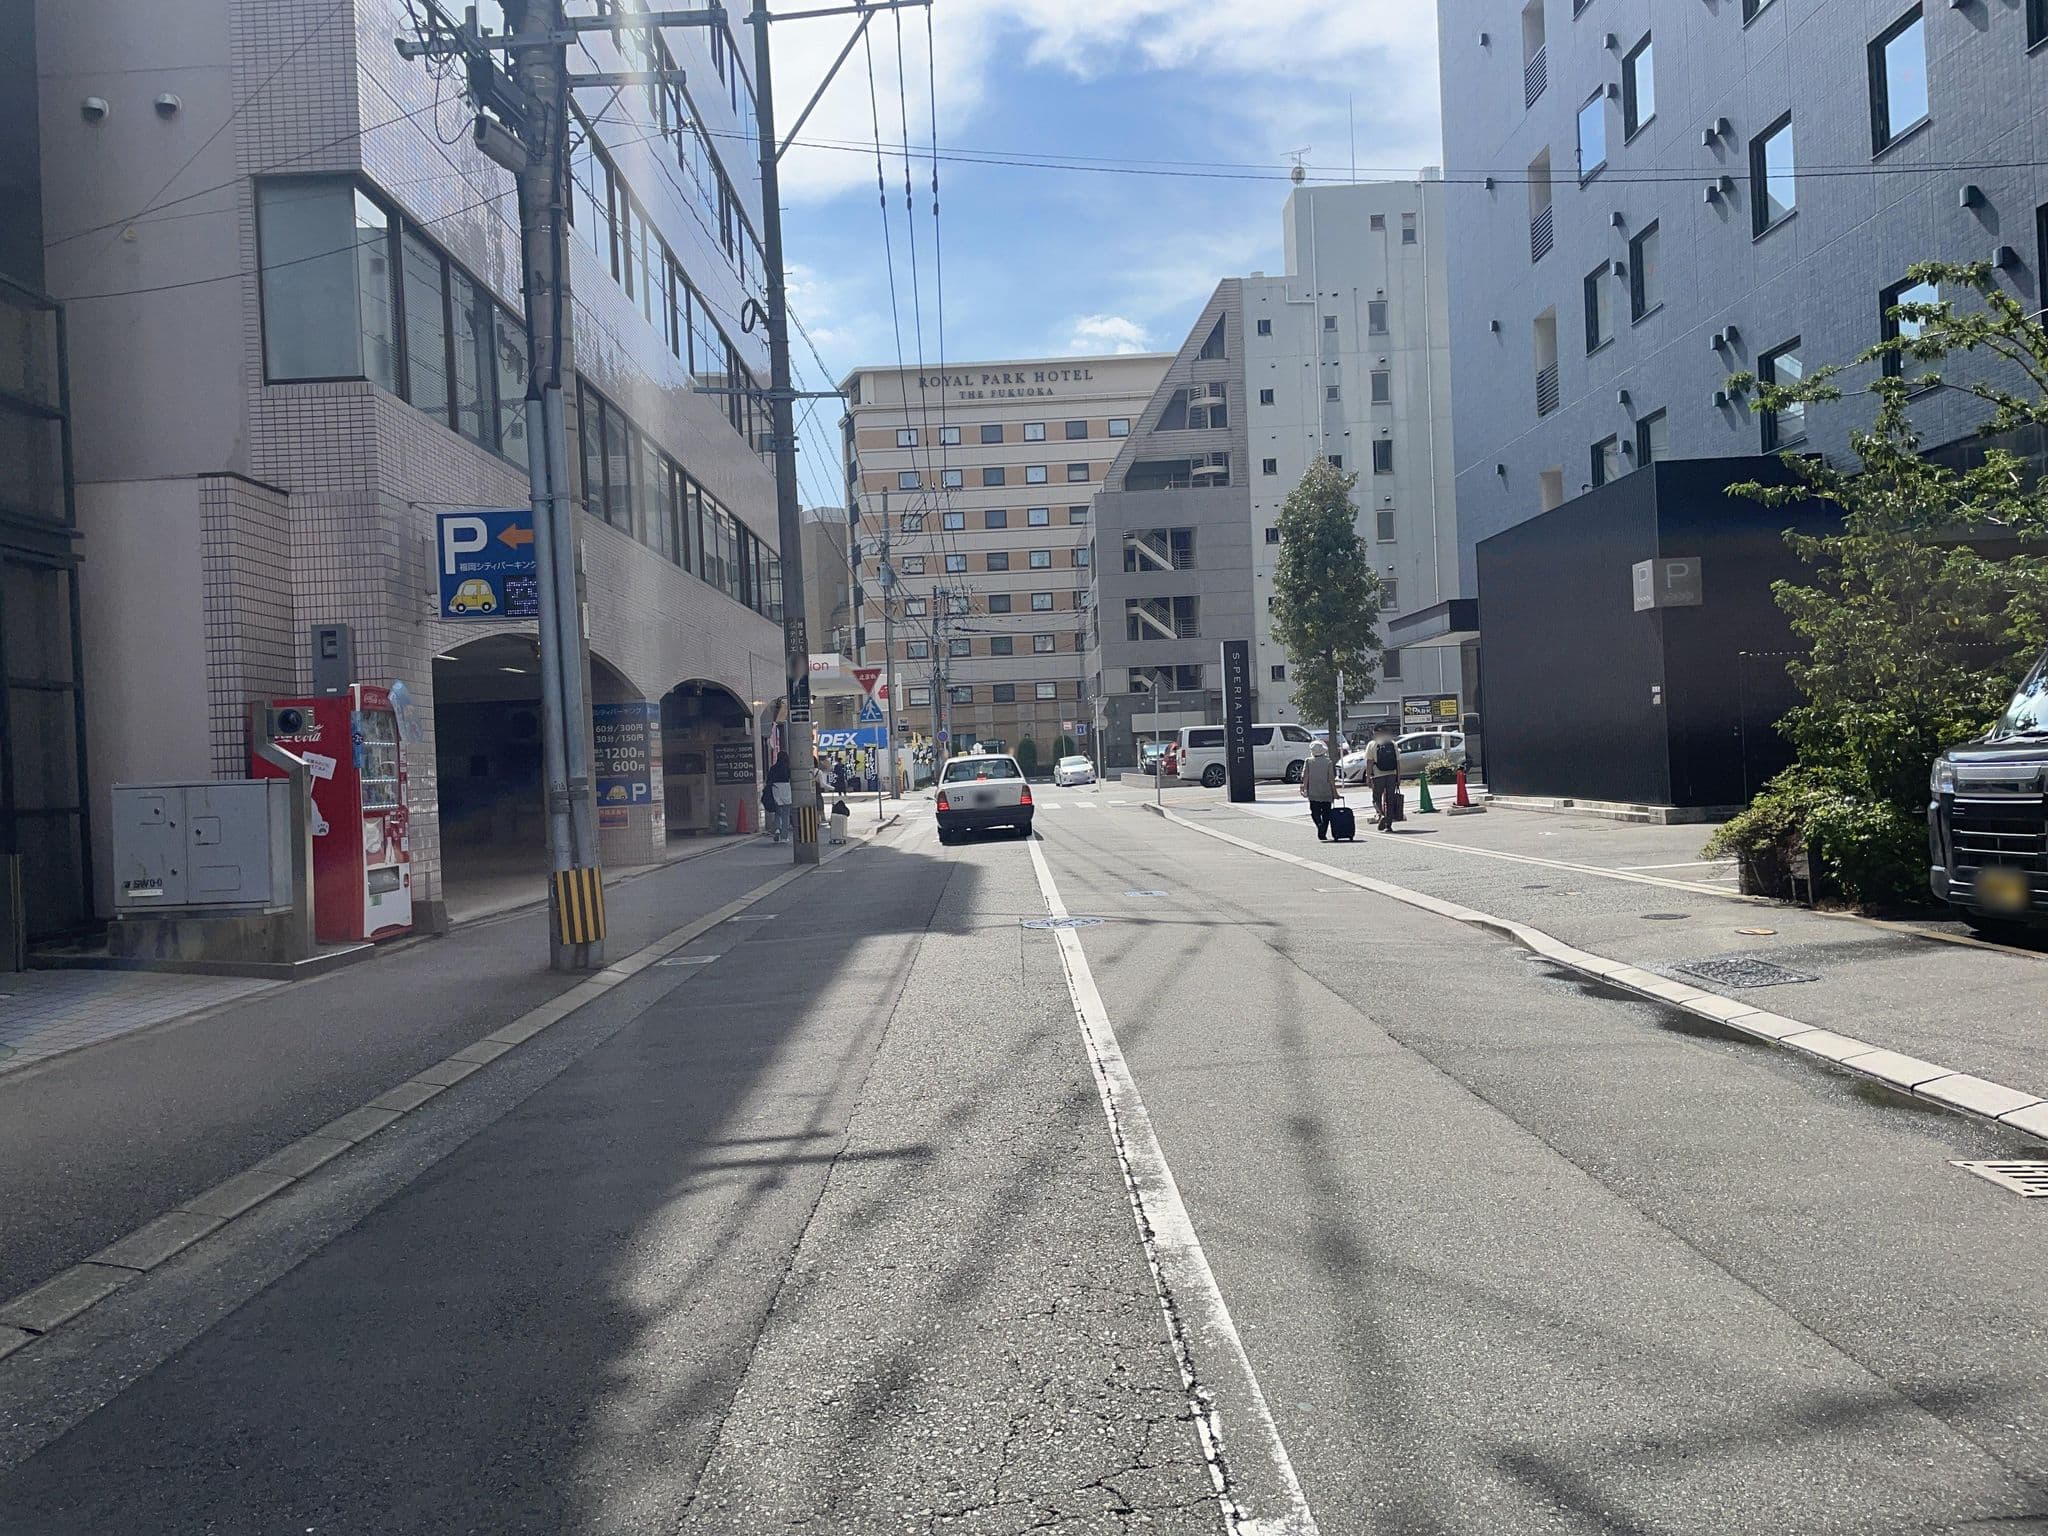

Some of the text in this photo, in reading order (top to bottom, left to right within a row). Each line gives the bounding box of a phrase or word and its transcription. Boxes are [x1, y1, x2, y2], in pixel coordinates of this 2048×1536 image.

[919, 369, 1094, 388] ROYAL PARK HOTEL
[959, 387, 1054, 400] THE FUKUOKA
[443, 517, 488, 575] P
[1666, 563, 1689, 588] P
[1235, 716, 1246, 764] HOTEL
[605, 746, 645, 759] 1200円
[612, 760, 646, 772] 600円
[632, 783, 647, 801] P
